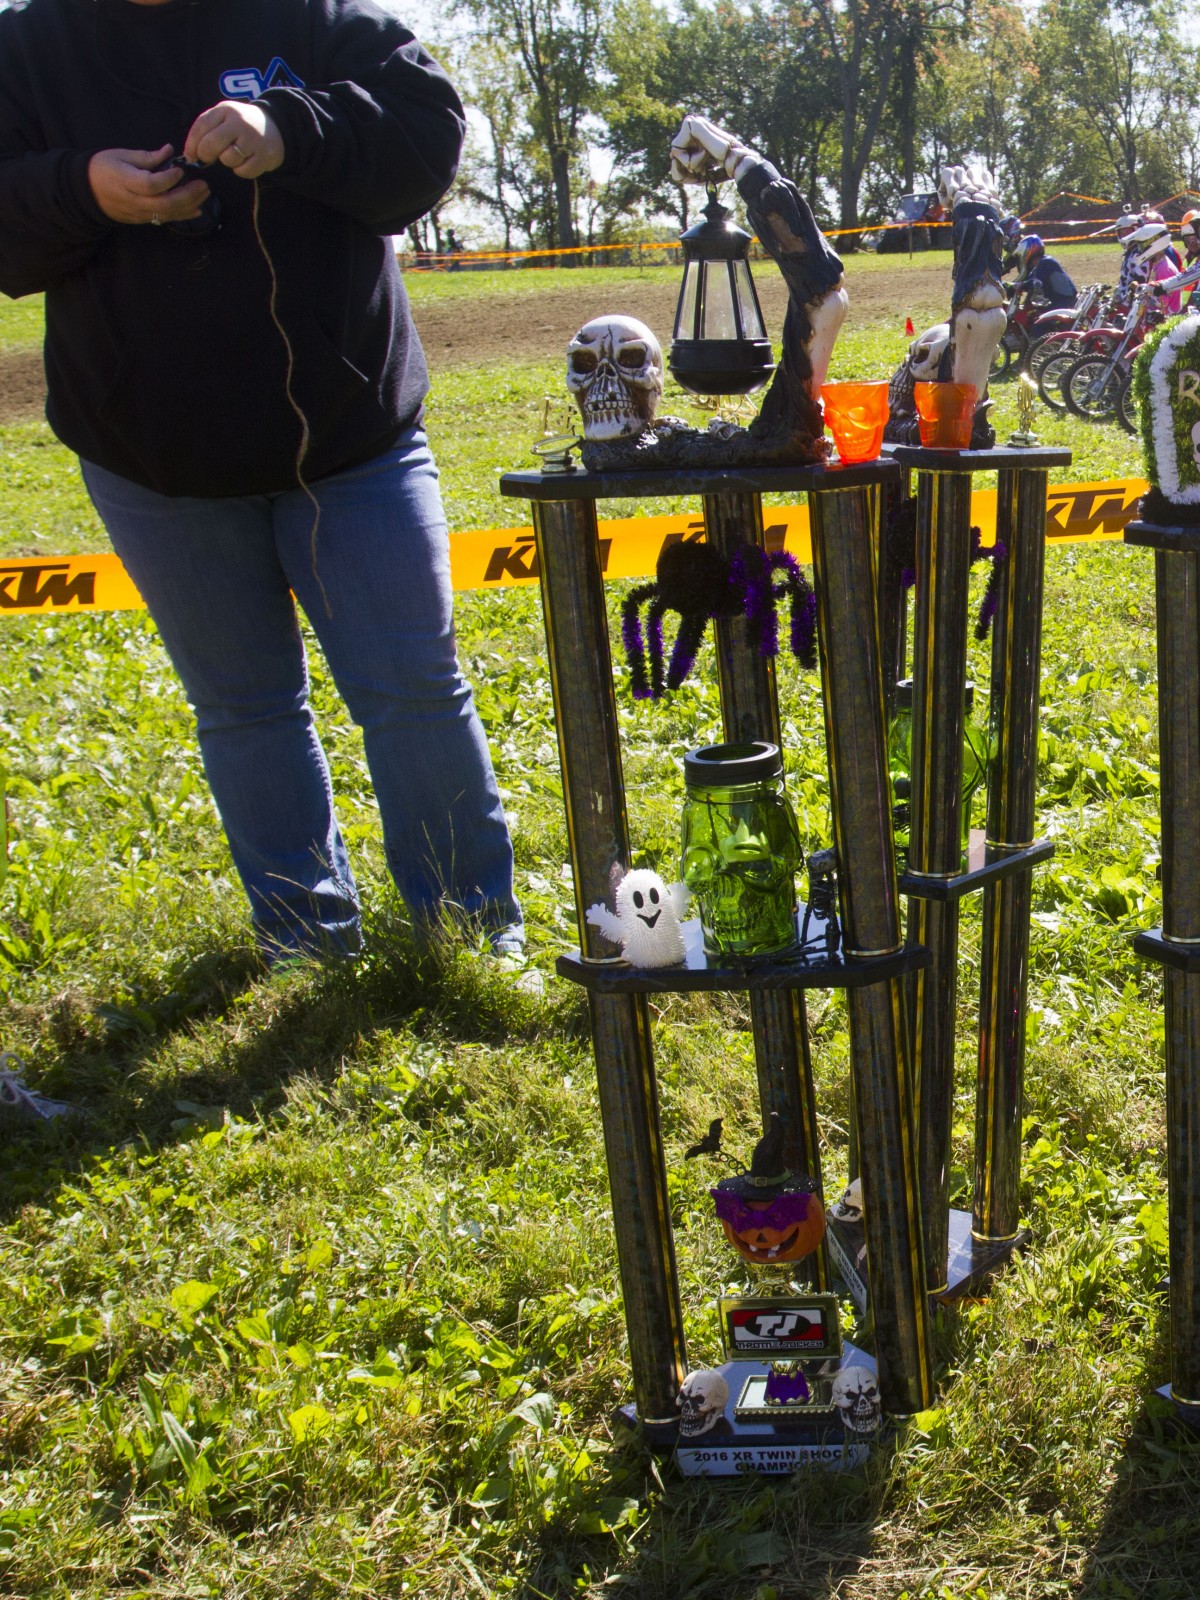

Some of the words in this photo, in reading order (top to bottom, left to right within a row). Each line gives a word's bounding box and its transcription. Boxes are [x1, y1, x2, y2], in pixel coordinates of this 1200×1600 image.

[755, 1314, 799, 1337] TJ
[780, 1340, 824, 1349] JOCKEY
[694, 1451, 728, 1462] 2016
[732, 1451, 754, 1461] XR
[757, 1450, 796, 1460] TWIN
